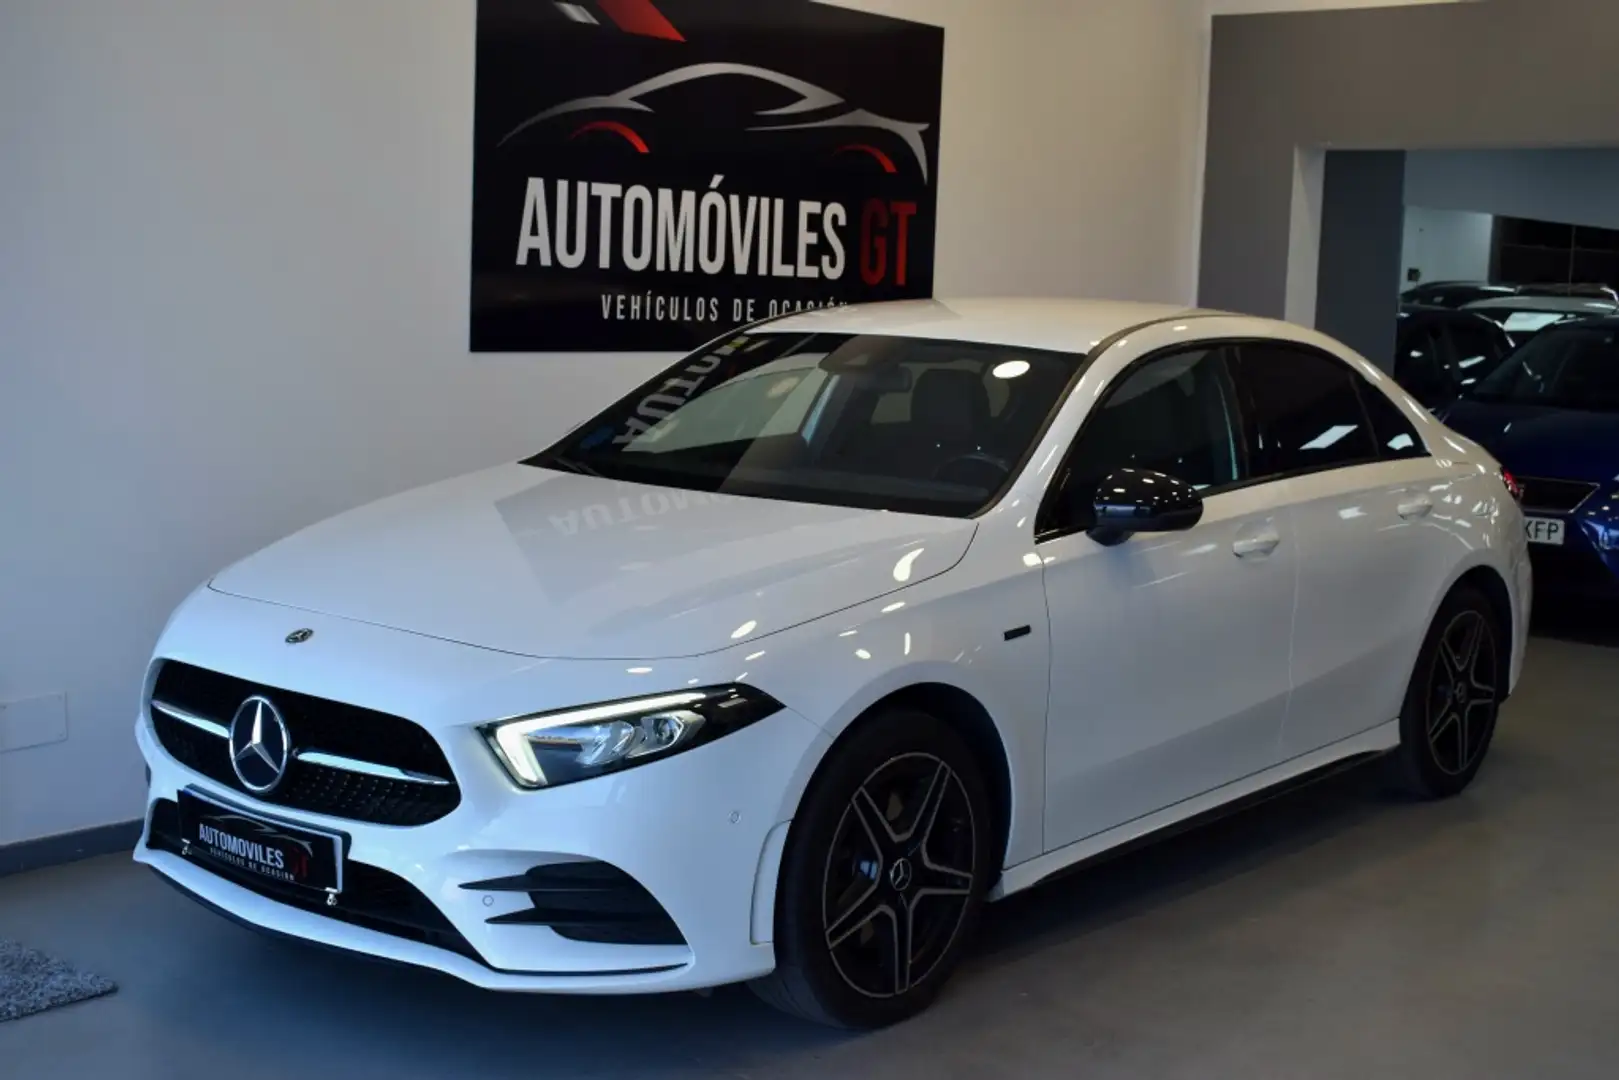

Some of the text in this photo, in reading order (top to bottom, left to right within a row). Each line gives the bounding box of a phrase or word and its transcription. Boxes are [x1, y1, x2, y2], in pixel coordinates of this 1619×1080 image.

[515, 174, 917, 287] AUTOMÓVILES GT
[601, 290, 719, 322] VEHÍCULOS
[733, 299, 755, 323] DE
